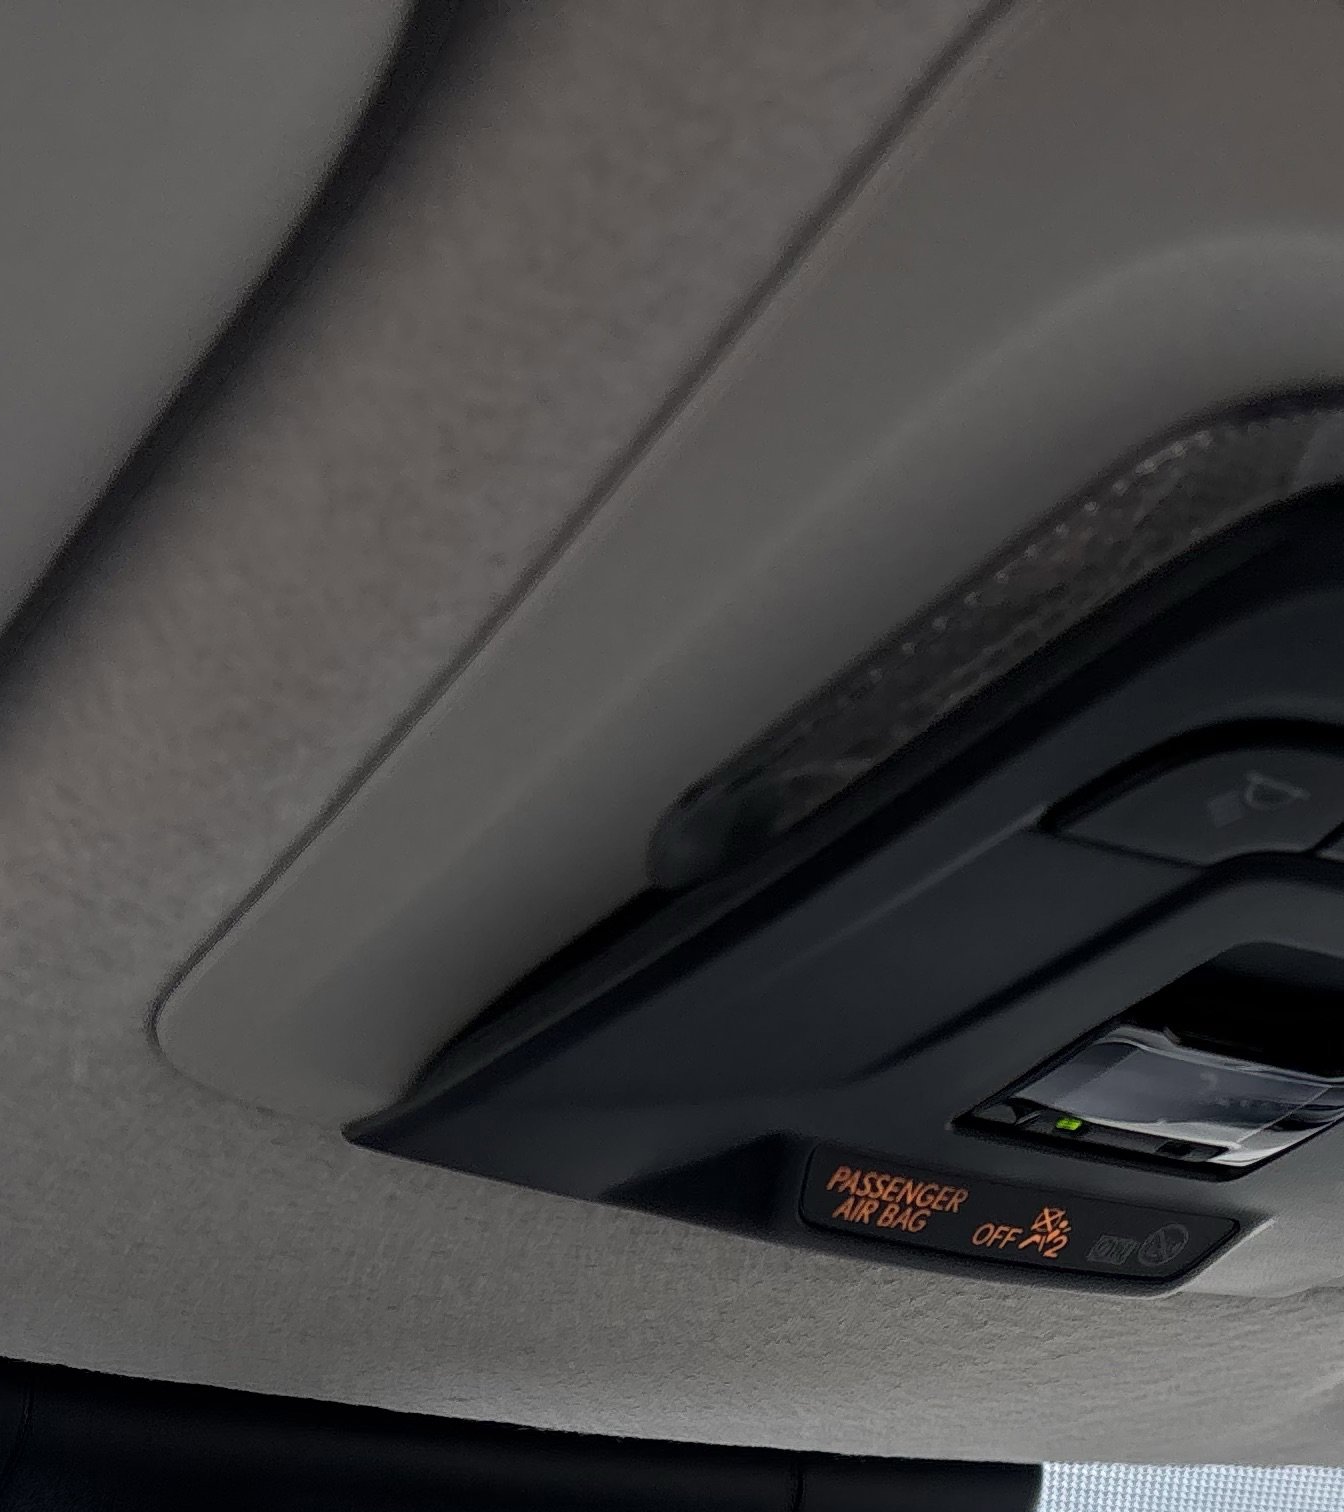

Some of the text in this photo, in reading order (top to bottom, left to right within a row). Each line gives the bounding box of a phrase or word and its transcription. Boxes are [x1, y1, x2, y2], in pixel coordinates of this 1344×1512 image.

[827, 1166, 967, 1213] PASSENGER
[833, 1198, 929, 1232] AIR BAG
[972, 1223, 1023, 1249] OFF
